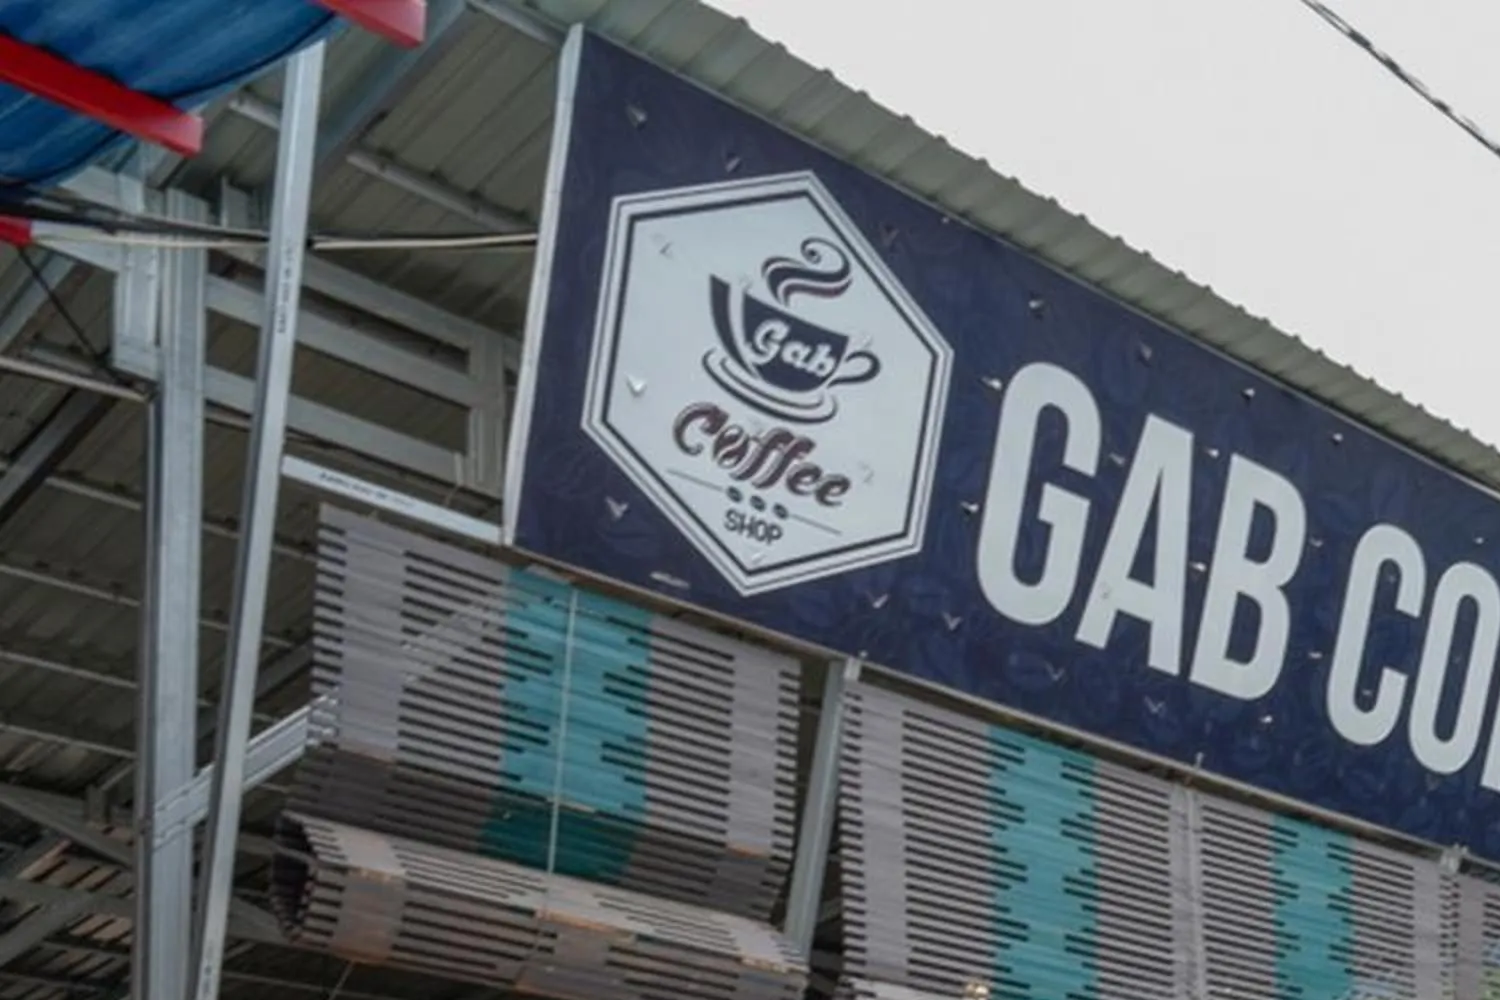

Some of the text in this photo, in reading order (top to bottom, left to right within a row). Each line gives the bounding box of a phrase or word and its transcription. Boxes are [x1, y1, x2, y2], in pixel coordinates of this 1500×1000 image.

[753, 319, 837, 378] Gab
[672, 400, 851, 507] Coffee
[723, 508, 783, 545] SHOP
[976, 362, 1307, 700] GAB
